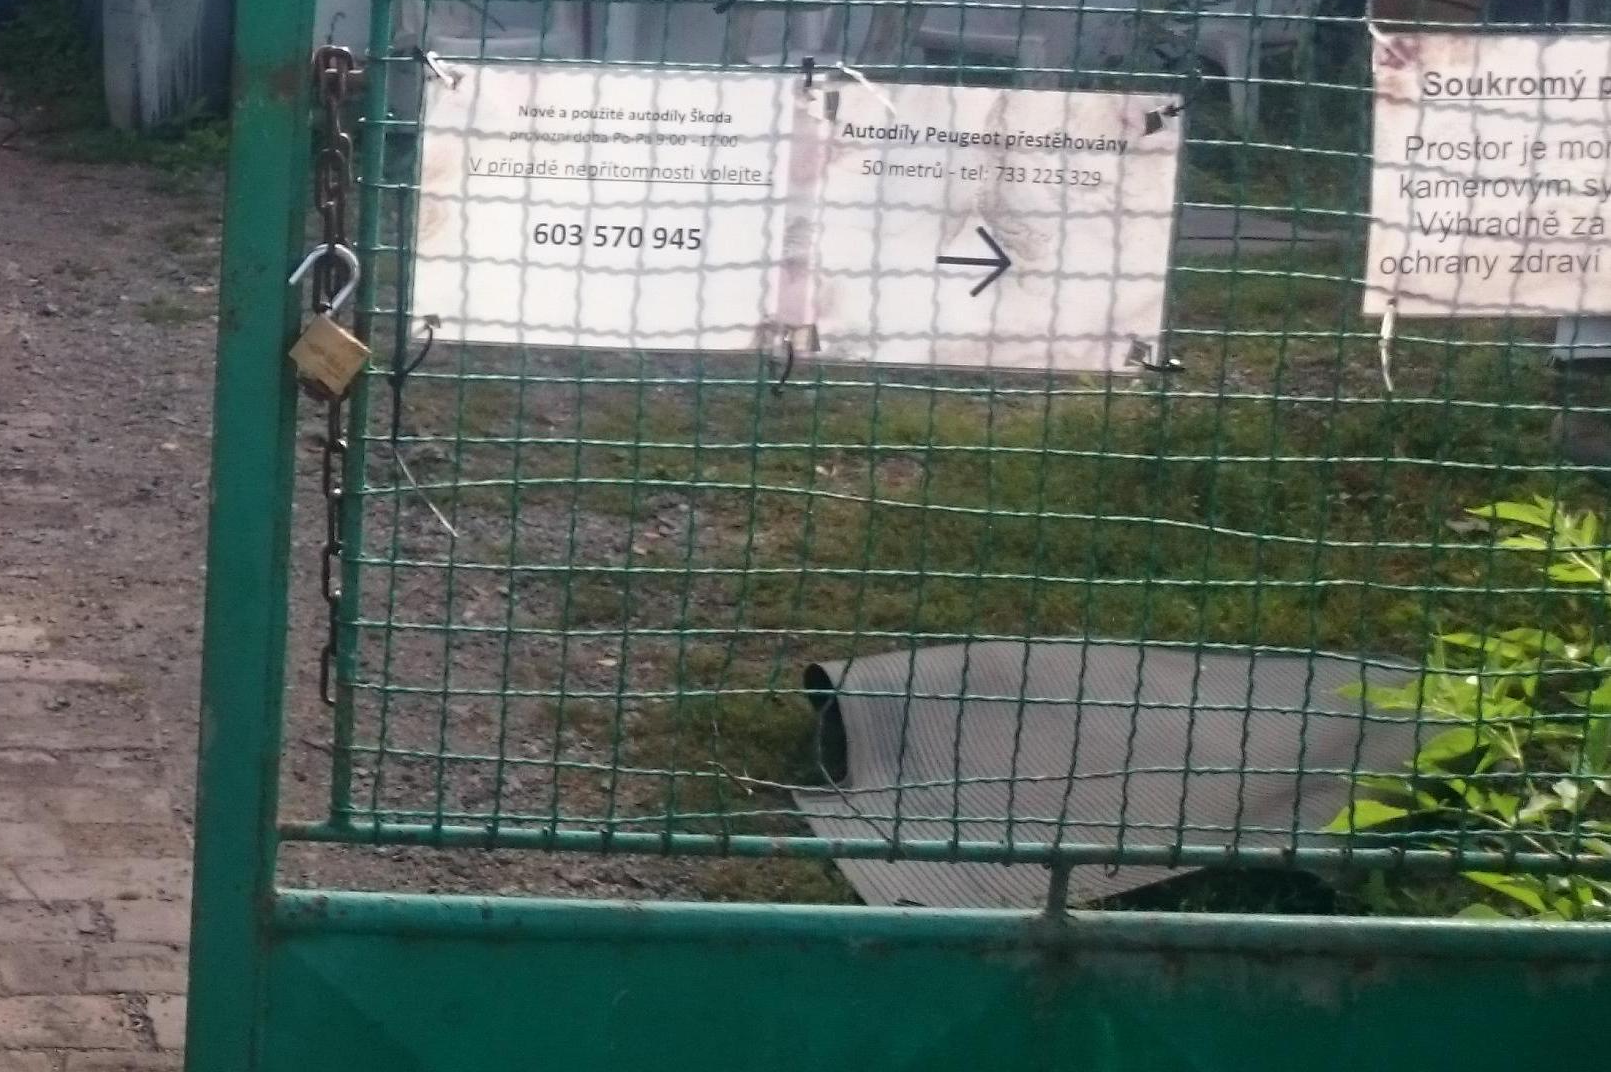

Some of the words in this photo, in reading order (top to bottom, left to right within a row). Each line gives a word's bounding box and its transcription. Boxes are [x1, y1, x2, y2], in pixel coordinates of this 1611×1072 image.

[1422, 69, 1587, 101] Soukromý
[518, 104, 556, 119] Nové
[558, 108, 568, 119] a
[689, 107, 733, 124] Škoda
[655, 133, 687, 147] 9:00
[700, 135, 738, 148] 17:00
[925, 126, 1001, 148] Peugeot
[1004, 130, 1128, 155] přestěhovány
[1404, 134, 1513, 161] Prostor
[1519, 134, 1548, 167] je
[468, 157, 483, 173] V
[564, 160, 695, 181] nepřítomnosti
[700, 165, 762, 184] volejte
[860, 159, 884, 176] 50
[889, 160, 943, 179] metrů
[960, 164, 988, 181] tel:
[995, 165, 1026, 184] 733
[1031, 167, 1064, 185] 225
[1068, 169, 1102, 186] 329
[1399, 173, 1572, 205] kamerovým
[533, 222, 583, 246] 603
[592, 224, 644, 249] 570
[652, 227, 702, 251] 945
[1416, 209, 1561, 243] Výhradně
[1571, 215, 1605, 236] za
[1379, 249, 1499, 281] ochrany
[1508, 248, 1602, 274] zdraví
